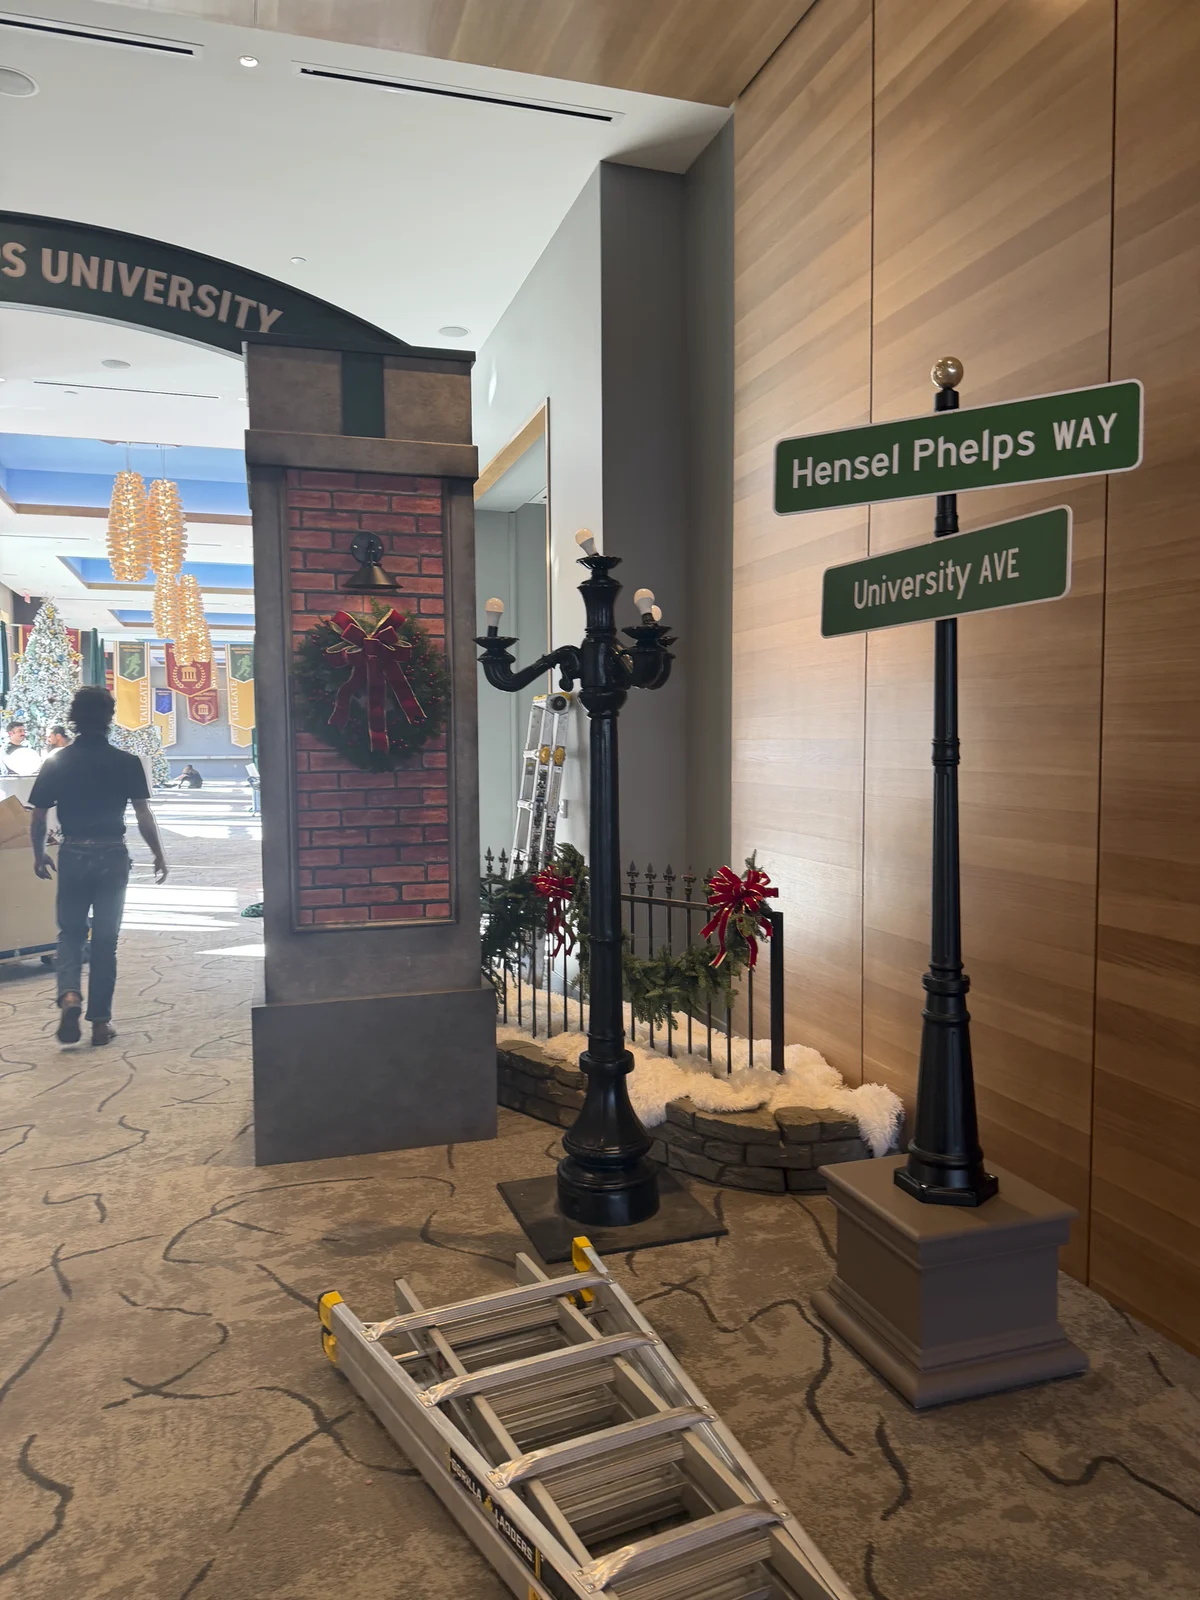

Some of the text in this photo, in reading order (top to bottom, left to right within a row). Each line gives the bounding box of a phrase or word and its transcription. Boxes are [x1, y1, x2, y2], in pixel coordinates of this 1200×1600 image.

[41, 247, 284, 333] UNIVERSITY
[793, 412, 1118, 489] Hensel Phelps WAY
[854, 547, 1019, 609] University AVE
[140, 680, 149, 723] TAILGATE
[230, 680, 240, 722] TAILGATE
[494, 1508, 534, 1562] LADDERS
